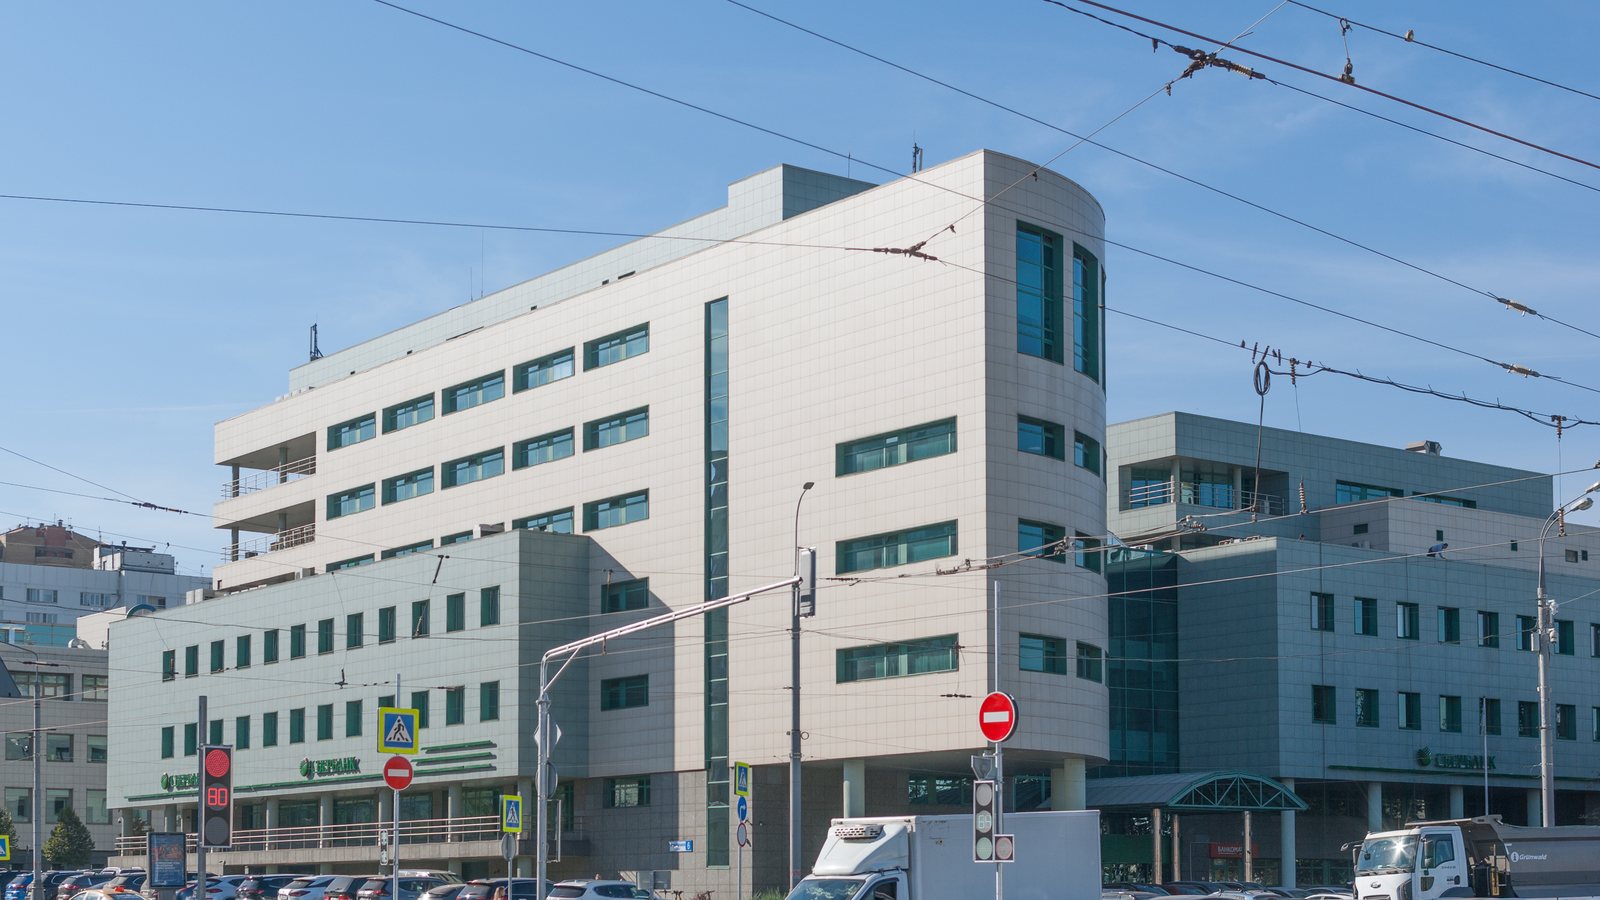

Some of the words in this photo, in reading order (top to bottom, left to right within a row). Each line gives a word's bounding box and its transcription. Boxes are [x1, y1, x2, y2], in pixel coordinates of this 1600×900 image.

[311, 757, 360, 775] СБЕРБАНК
[169, 773, 199, 789] СБЕРБА
[207, 787, 229, 806] 80
